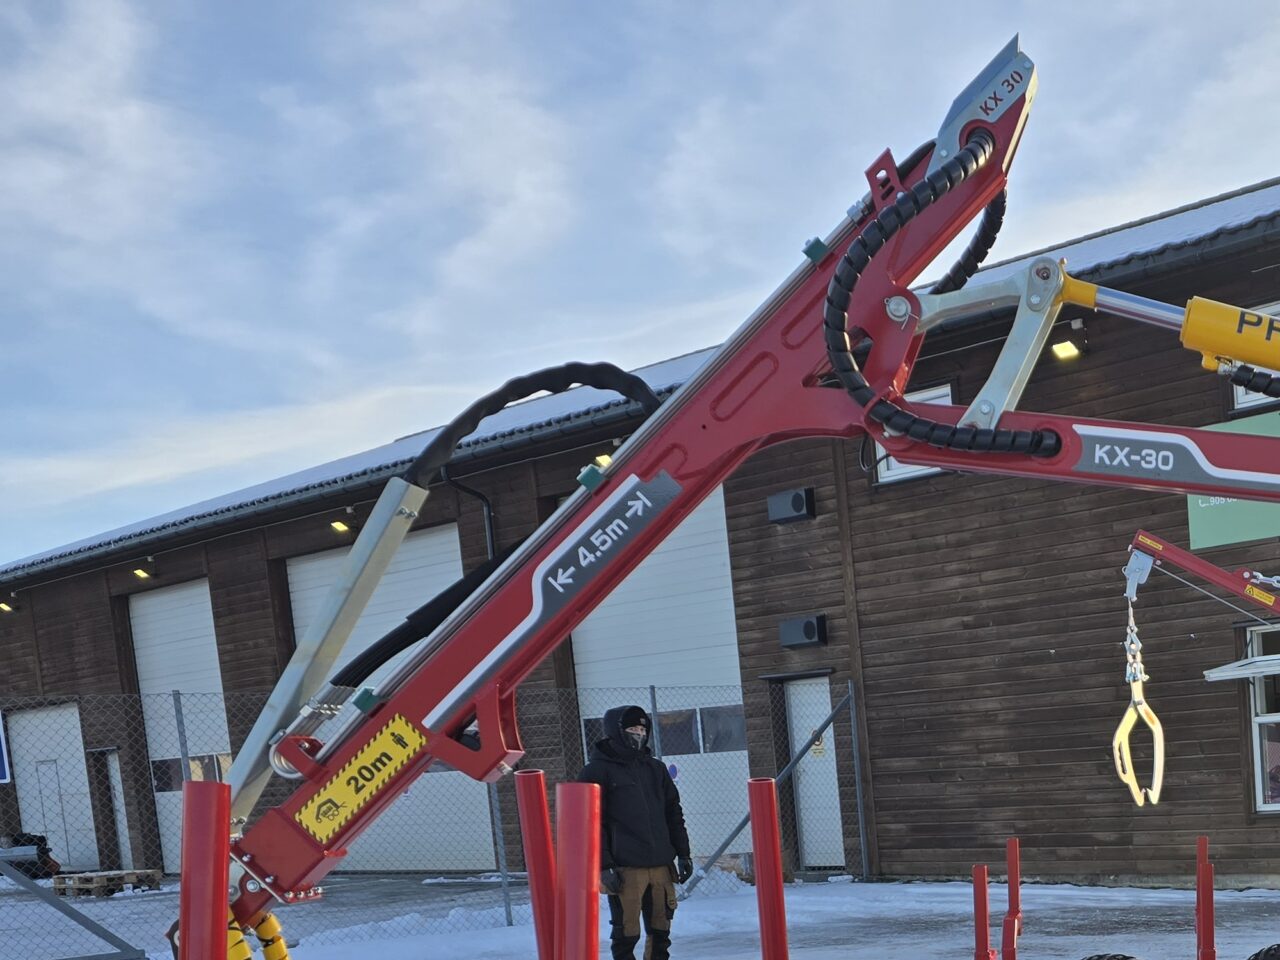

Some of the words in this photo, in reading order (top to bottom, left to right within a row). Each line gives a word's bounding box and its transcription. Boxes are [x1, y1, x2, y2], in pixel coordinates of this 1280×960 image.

[979, 90, 1004, 116] KX
[1001, 70, 1023, 93] 30
[1094, 443, 1174, 471] KX-30
[577, 518, 629, 567] 4.5m
[346, 751, 393, 795] 20m
